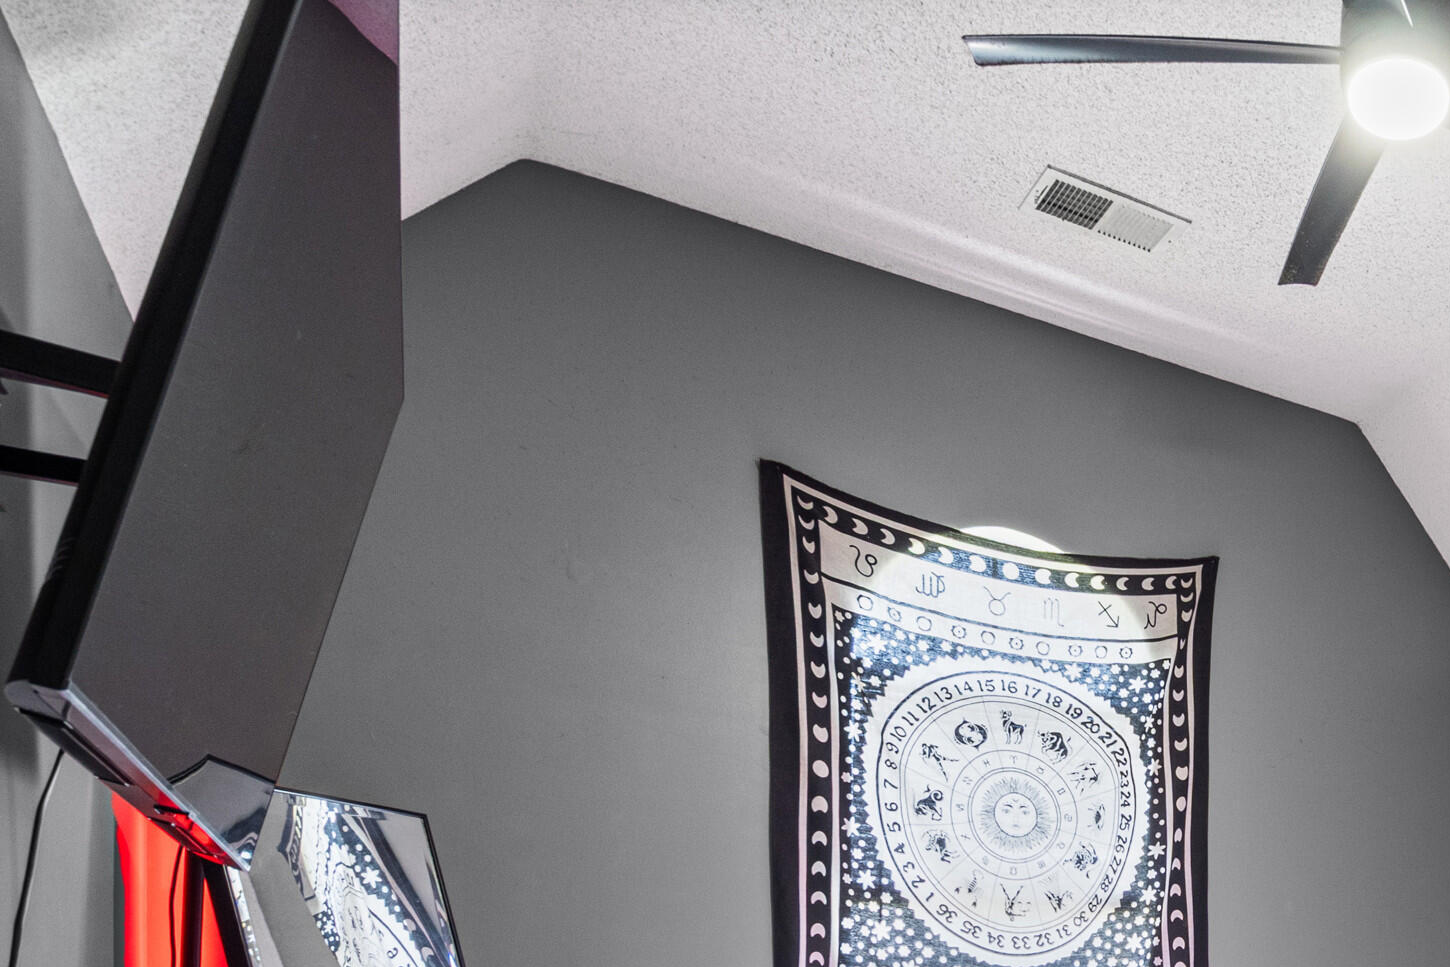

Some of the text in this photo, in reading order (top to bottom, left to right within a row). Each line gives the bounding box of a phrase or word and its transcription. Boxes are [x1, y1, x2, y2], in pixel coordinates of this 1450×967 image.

[883, 679, 1132, 950] 1 2 3 4 5 6 7 8 9 10 11 12 13 14 15 16 17 18 19 20 21 22 23 24 25 26 27 28 29 30 31 32 33 34 35 36
